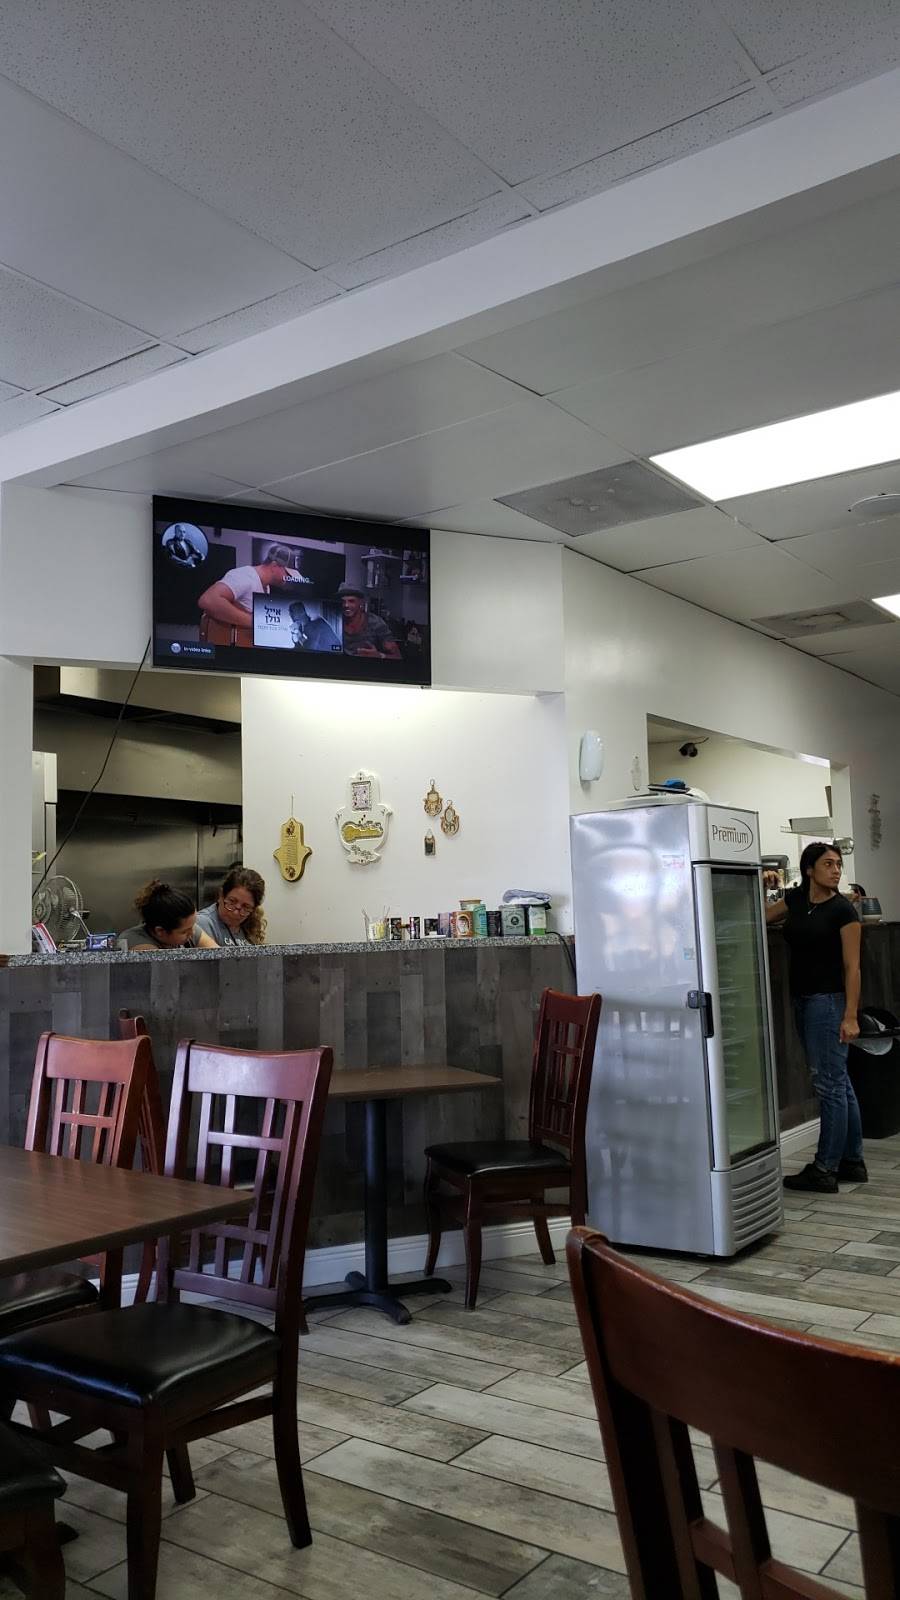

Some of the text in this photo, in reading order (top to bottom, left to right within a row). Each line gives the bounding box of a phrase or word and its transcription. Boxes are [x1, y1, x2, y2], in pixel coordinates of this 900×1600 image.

[263, 604, 281, 615] אייל
[265, 614, 281, 623] גולן
[712, 825, 749, 844] Premium
